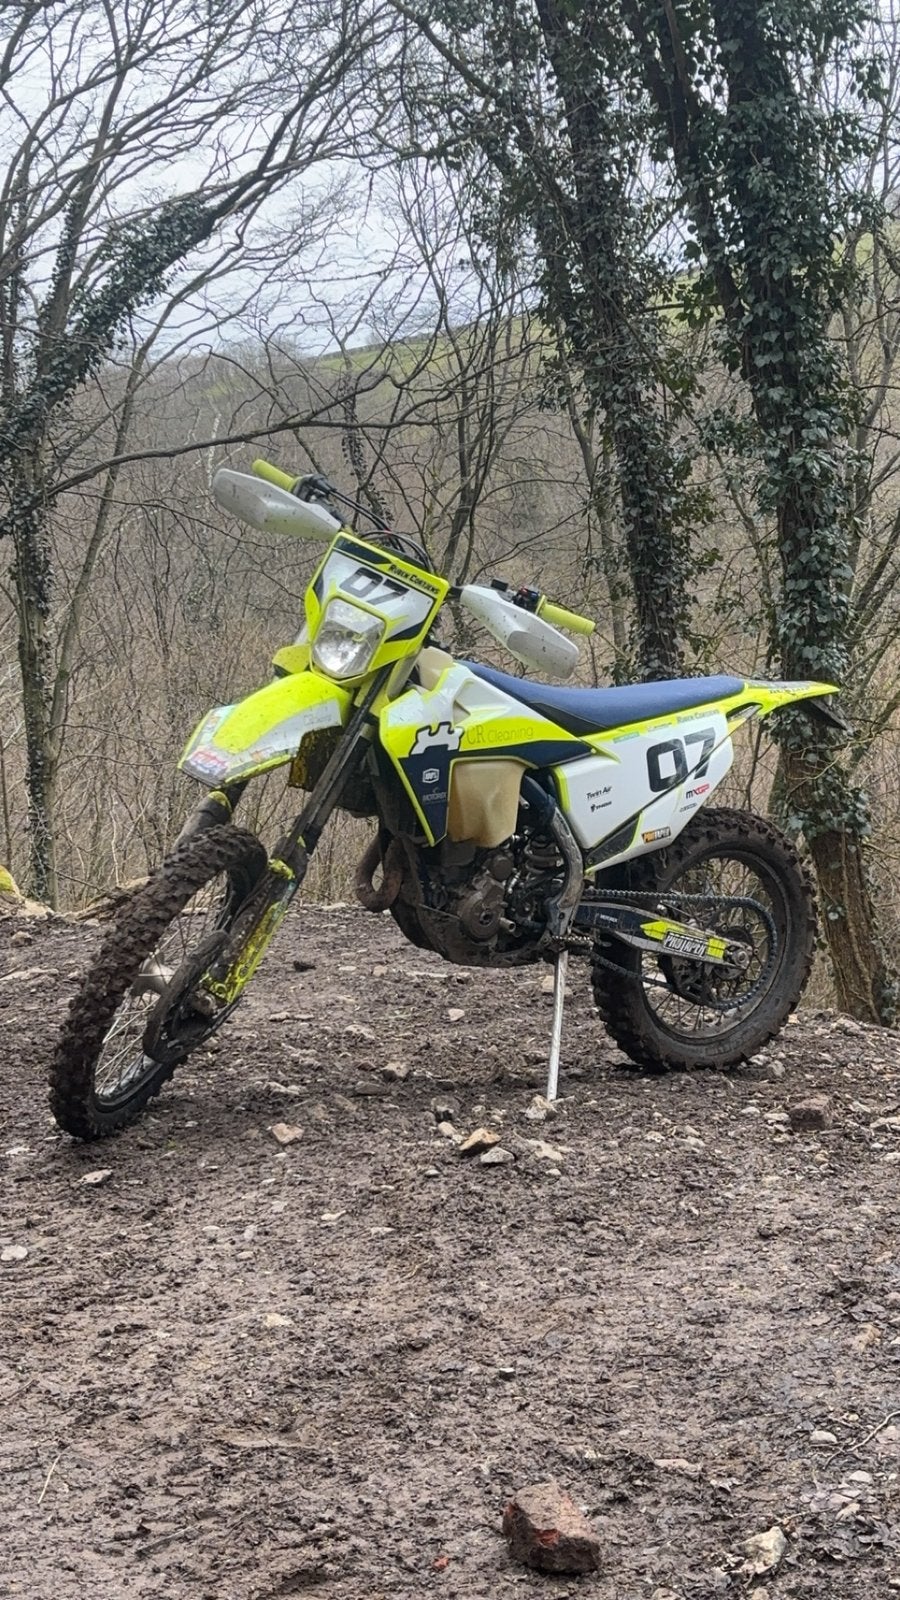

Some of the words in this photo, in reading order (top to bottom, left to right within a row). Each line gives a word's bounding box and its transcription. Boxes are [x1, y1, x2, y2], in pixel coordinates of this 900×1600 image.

[340, 567, 410, 606] 07
[487, 726, 534, 741] Cleaning
[646, 727, 716, 793] 07
